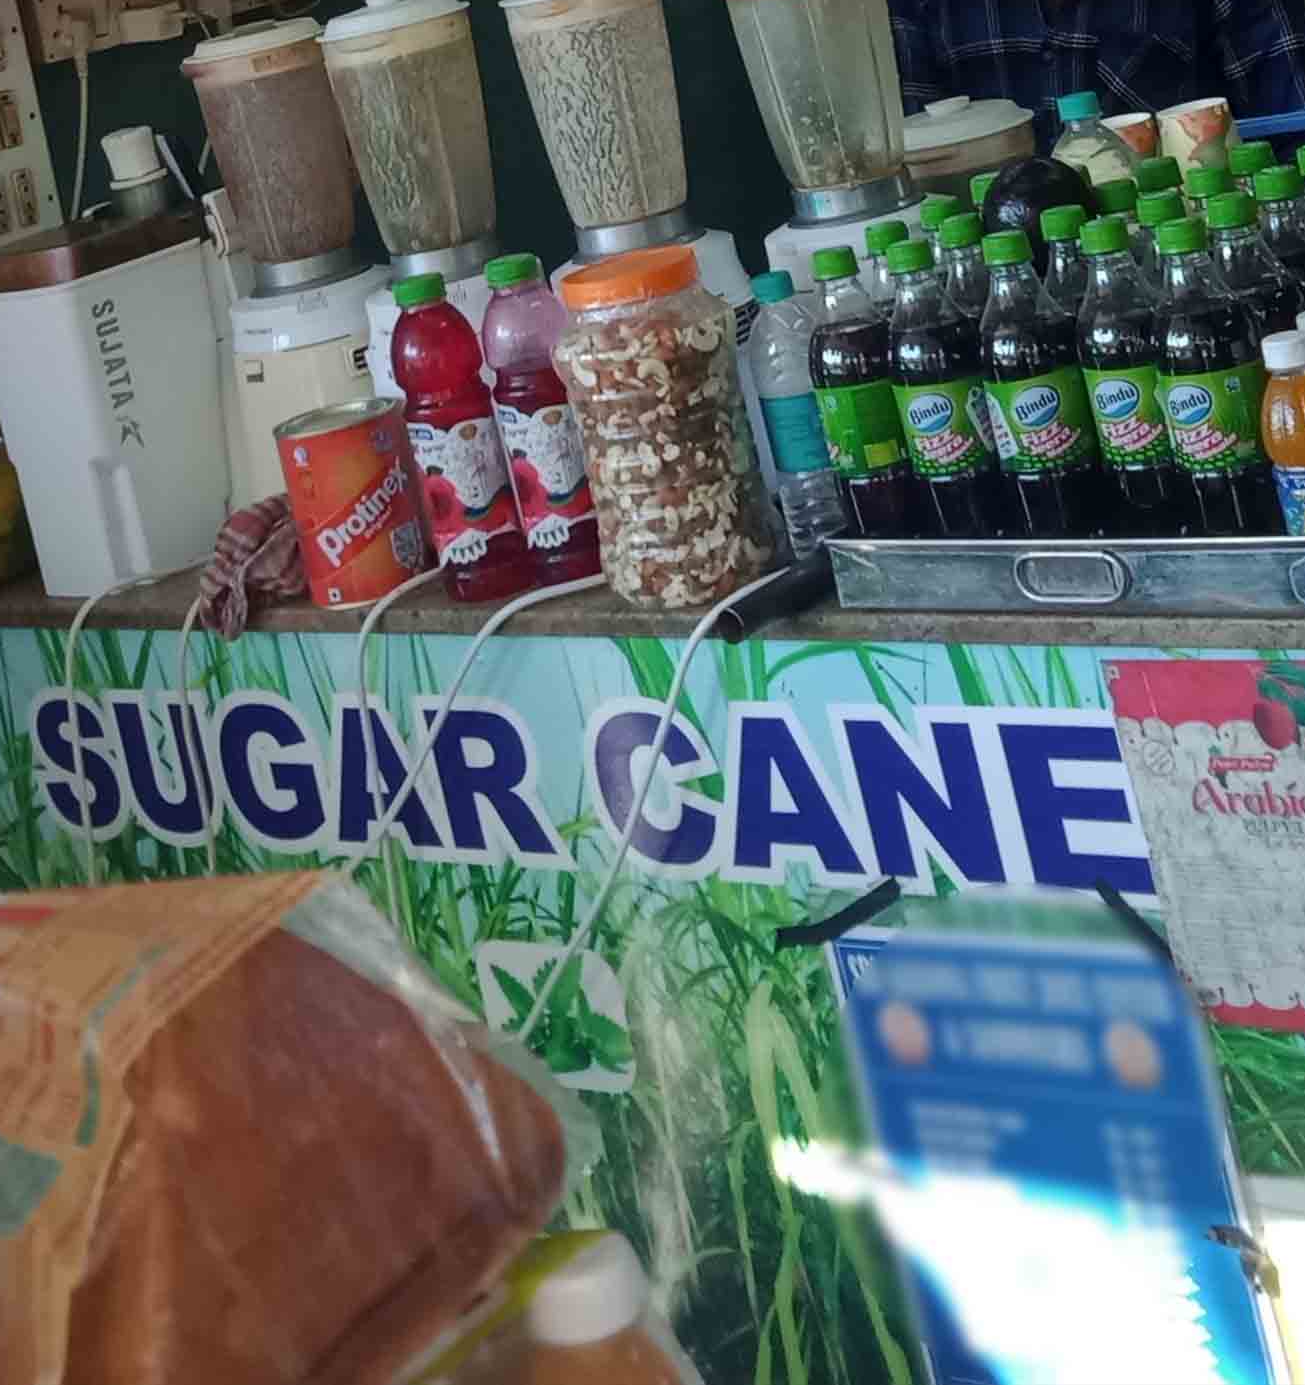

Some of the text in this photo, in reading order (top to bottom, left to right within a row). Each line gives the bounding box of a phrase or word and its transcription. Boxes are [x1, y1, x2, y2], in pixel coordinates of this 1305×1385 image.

[91, 298, 135, 409] SUJATA
[909, 398, 952, 426] Bindu
[1016, 391, 1057, 421] Bindu
[1096, 386, 1136, 411] Bindu
[1169, 390, 1207, 417] Bindu
[32, 694, 1157, 896] SUGAR CANE
